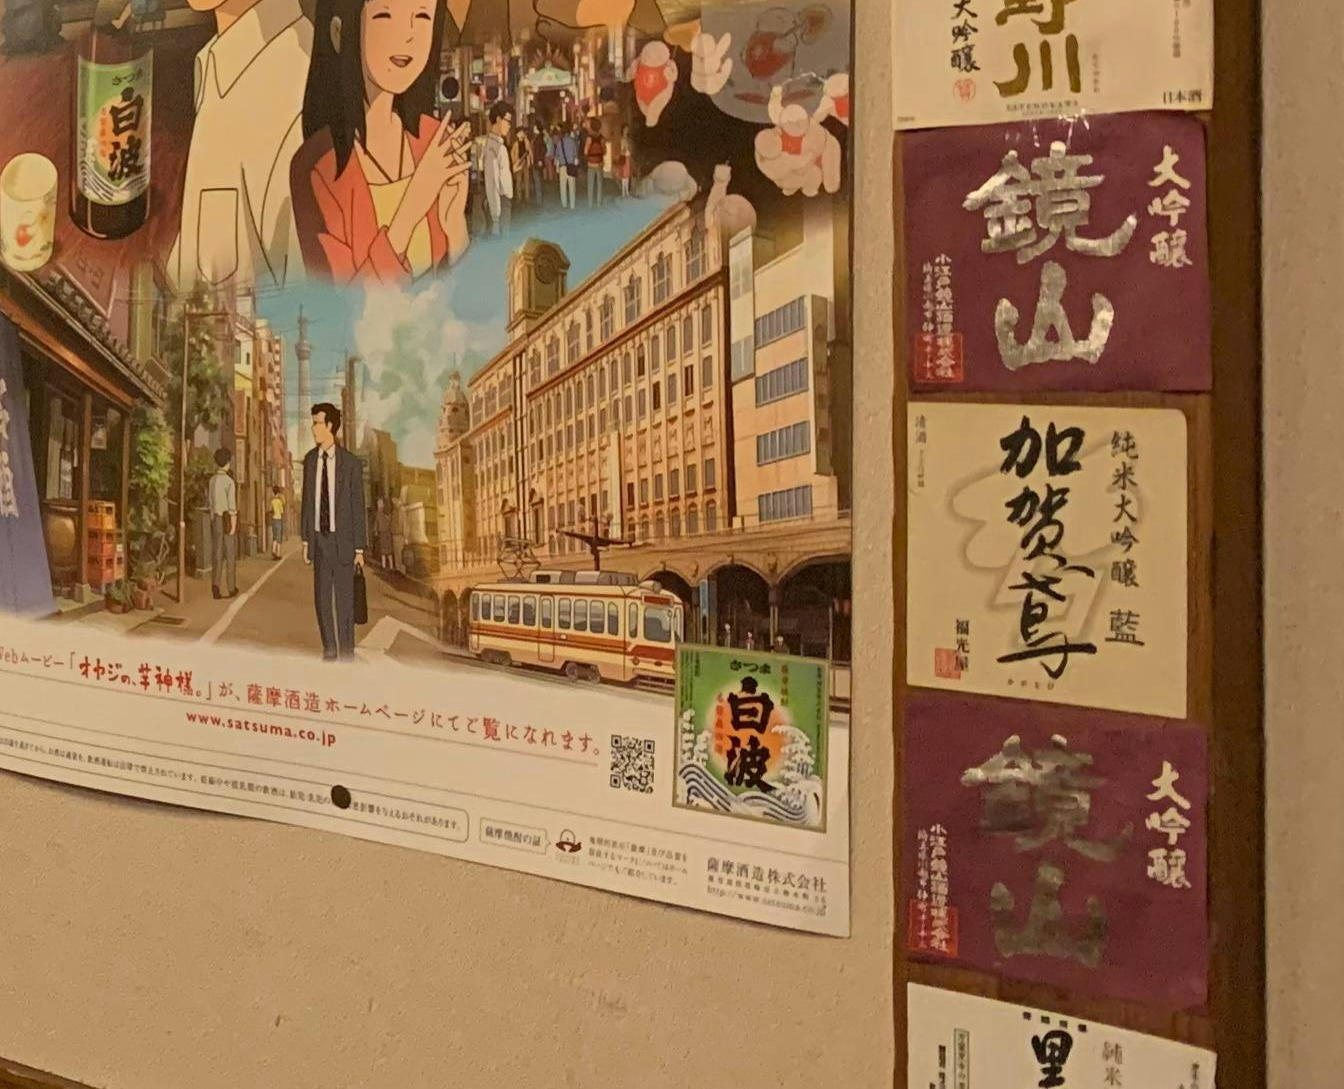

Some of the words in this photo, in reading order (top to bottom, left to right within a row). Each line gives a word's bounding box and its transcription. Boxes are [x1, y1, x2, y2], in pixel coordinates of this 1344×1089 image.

[1163, 89, 1202, 104] 日本酒
[963, 140, 1137, 370] 鏡山
[186, 711, 338, 747] www.satsuma.co.jp
[724, 676, 778, 792] 白波
[1145, 760, 1191, 889] 大吟醸
